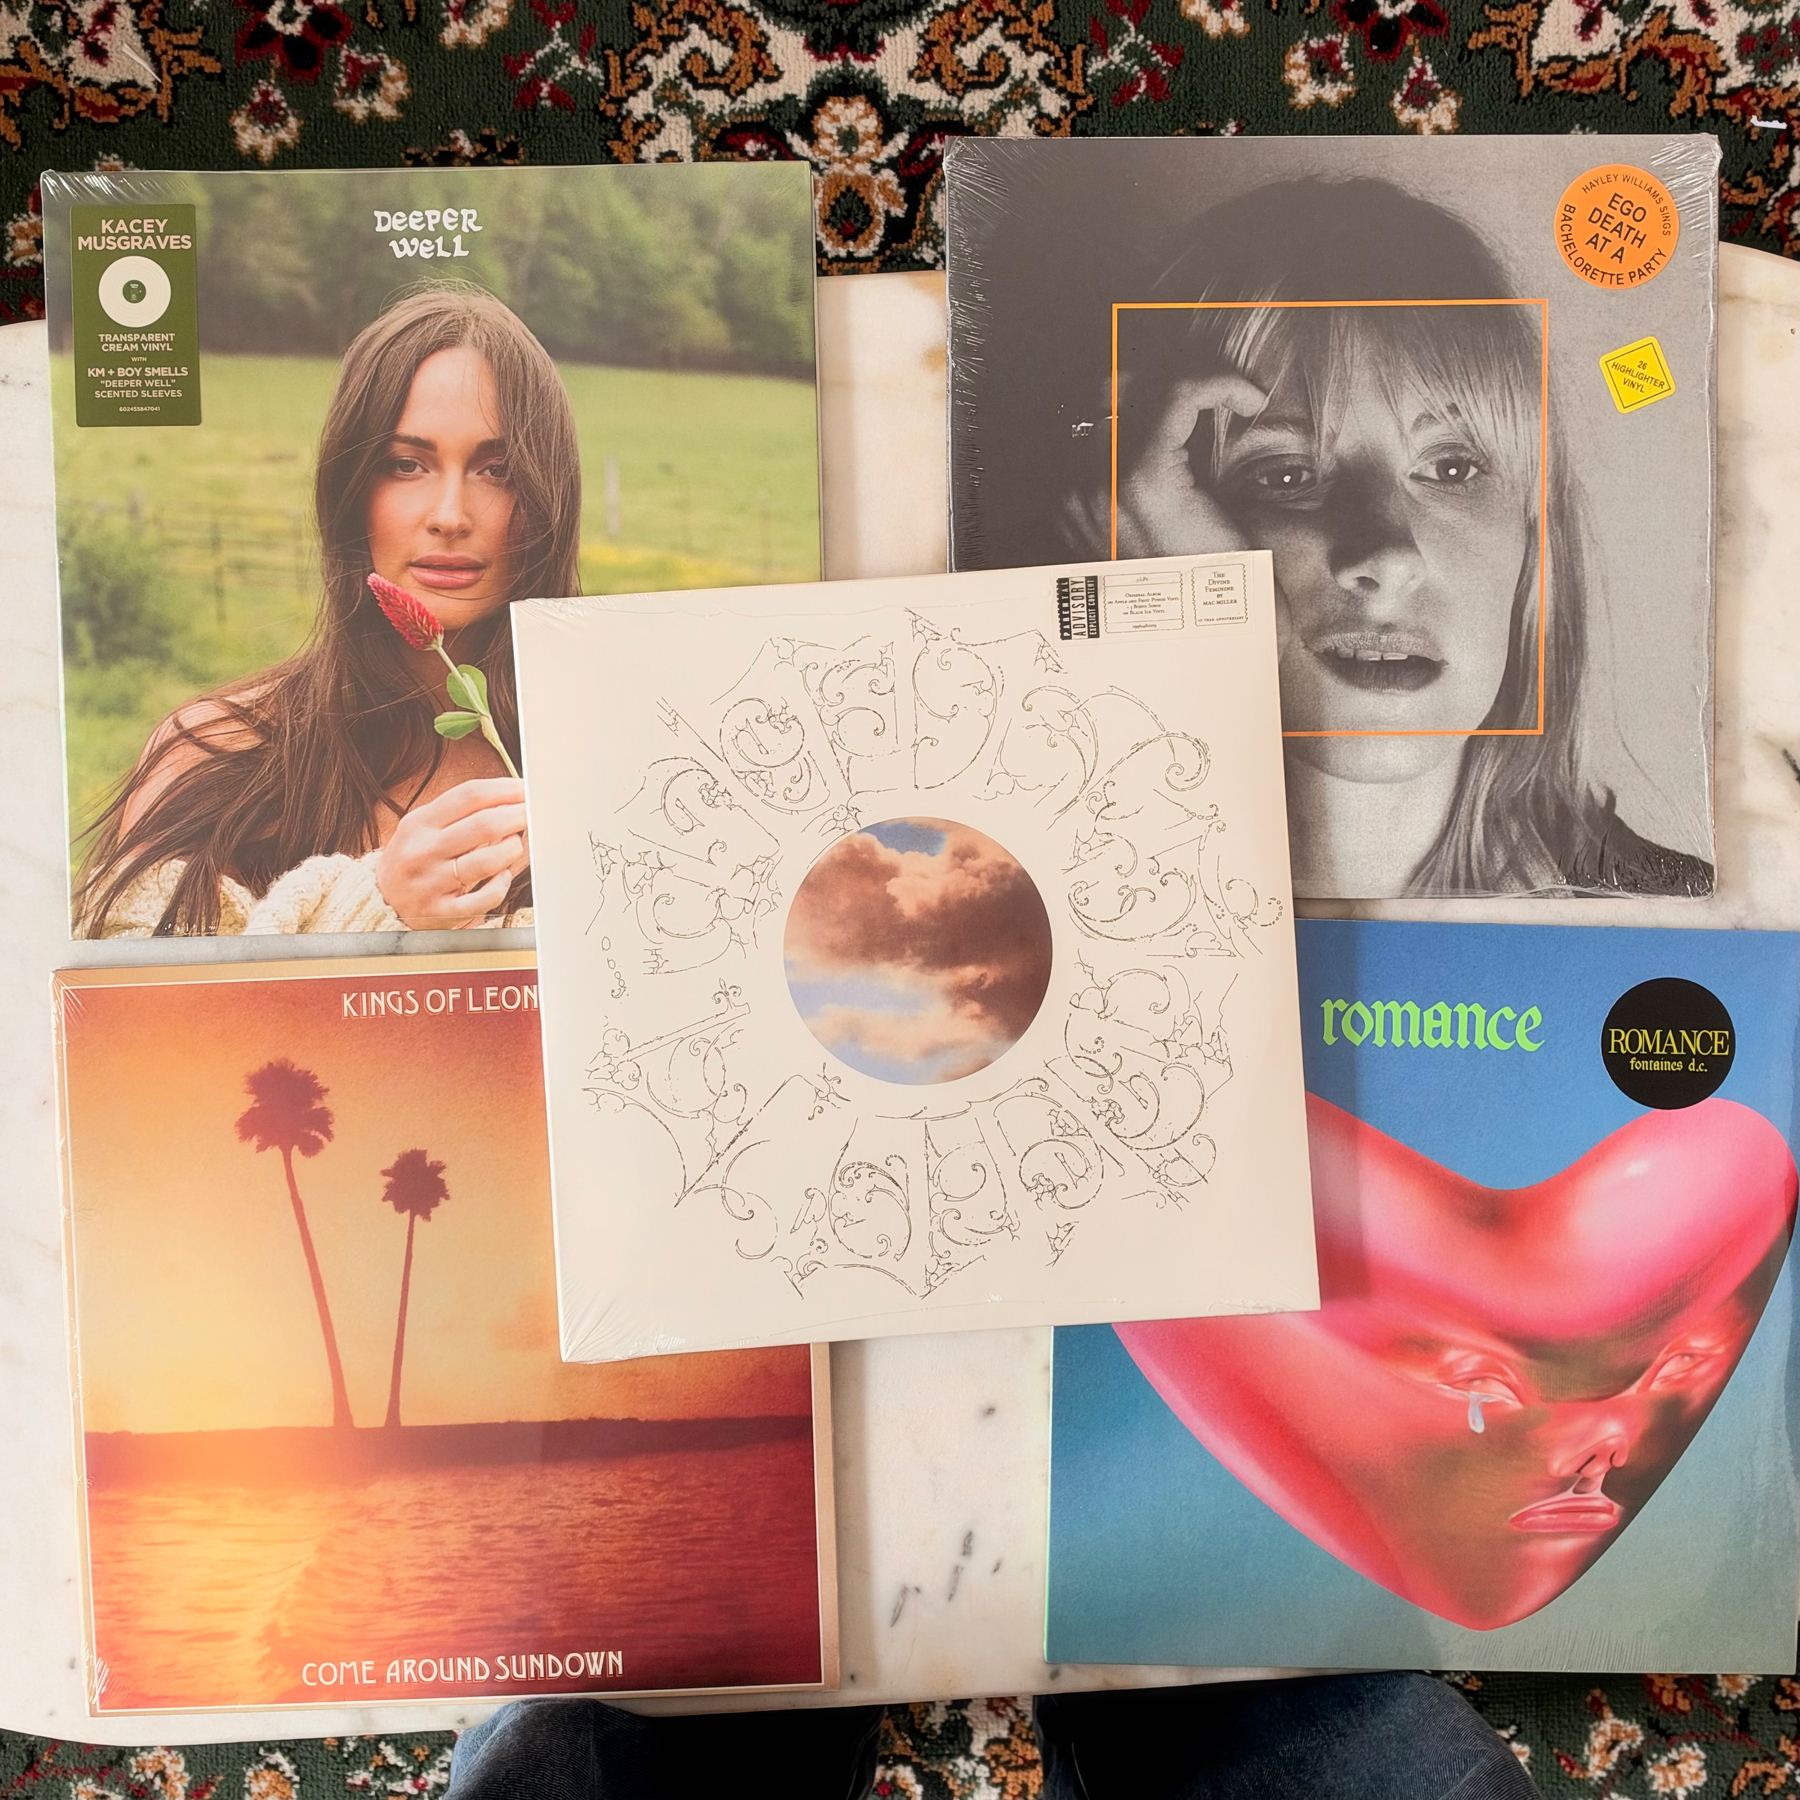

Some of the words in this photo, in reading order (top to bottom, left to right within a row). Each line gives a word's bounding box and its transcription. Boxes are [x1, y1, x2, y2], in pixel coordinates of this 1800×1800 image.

[1582, 174, 1619, 194] HAYLEY
[1622, 174, 1664, 205] WILLIAMS
[1660, 205, 1672, 236] SINGS
[1608, 192, 1647, 223] EGO
[101, 218, 169, 234] KACEY
[1587, 207, 1647, 249] DEATH
[77, 235, 193, 251] MUSGRAVES
[1560, 203, 1625, 285] BACHELORETTE
[1628, 248, 1667, 283] PARTY
[1585, 232, 1612, 254] AT
[1610, 246, 1625, 264] A
[98, 333, 175, 342] TRANSPARENT
[101, 343, 139, 352] CREAM
[141, 342, 173, 351] VINYL
[87, 367, 105, 378] KM
[107, 368, 115, 376] +
[117, 367, 142, 377] BOY
[144, 366, 189, 377] SMELLS
[1611, 361, 1665, 390] HIGHLIGHTER
[1637, 360, 1648, 370] 26
[94, 389, 139, 399] SCENTED
[140, 389, 183, 398] SLEEVES
[1623, 377, 1645, 394] VINYL
[1087, 579, 1096, 607] CONTENT
[1061, 580, 1071, 638] PARENTAL
[1070, 579, 1087, 637] ADVISORY
[1088, 608, 1098, 636] EXPLICIT
[341, 990, 420, 1018] KINGS
[424, 988, 461, 1013] OF
[466, 984, 539, 1013] LEON
[1320, 998, 1546, 1052] romance
[1608, 1028, 1730, 1056] ROMANCE
[1629, 1057, 1683, 1072] fontaines
[1688, 1057, 1708, 1073] d.c.
[302, 1660, 377, 1686] COME
[385, 1656, 490, 1684] AROUND
[494, 1650, 624, 1681] SUNDOWN
